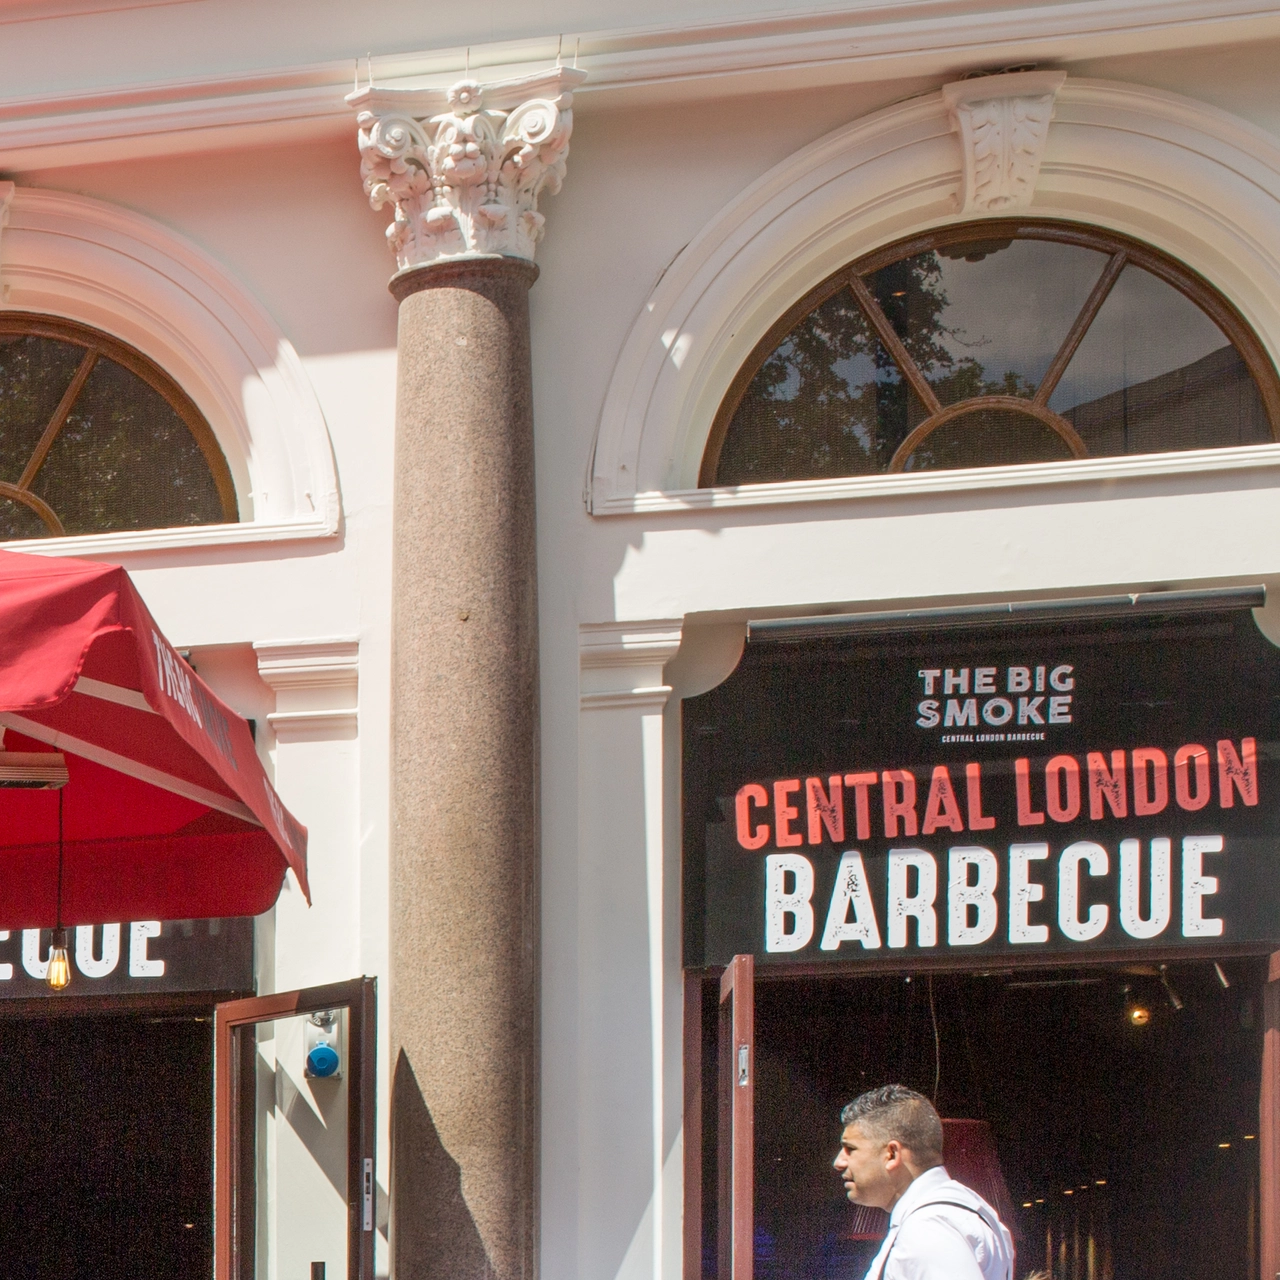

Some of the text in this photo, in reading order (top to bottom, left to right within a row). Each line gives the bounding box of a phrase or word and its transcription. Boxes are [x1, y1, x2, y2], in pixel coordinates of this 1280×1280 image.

[917, 664, 1075, 696] THE BIG
[915, 695, 1073, 729] SMOKE
[942, 734, 974, 743] CENTRAL
[976, 733, 1005, 742] LONDON
[734, 737, 1259, 850] CENTRAL LONDON
[764, 835, 1225, 954] BARBECUE
